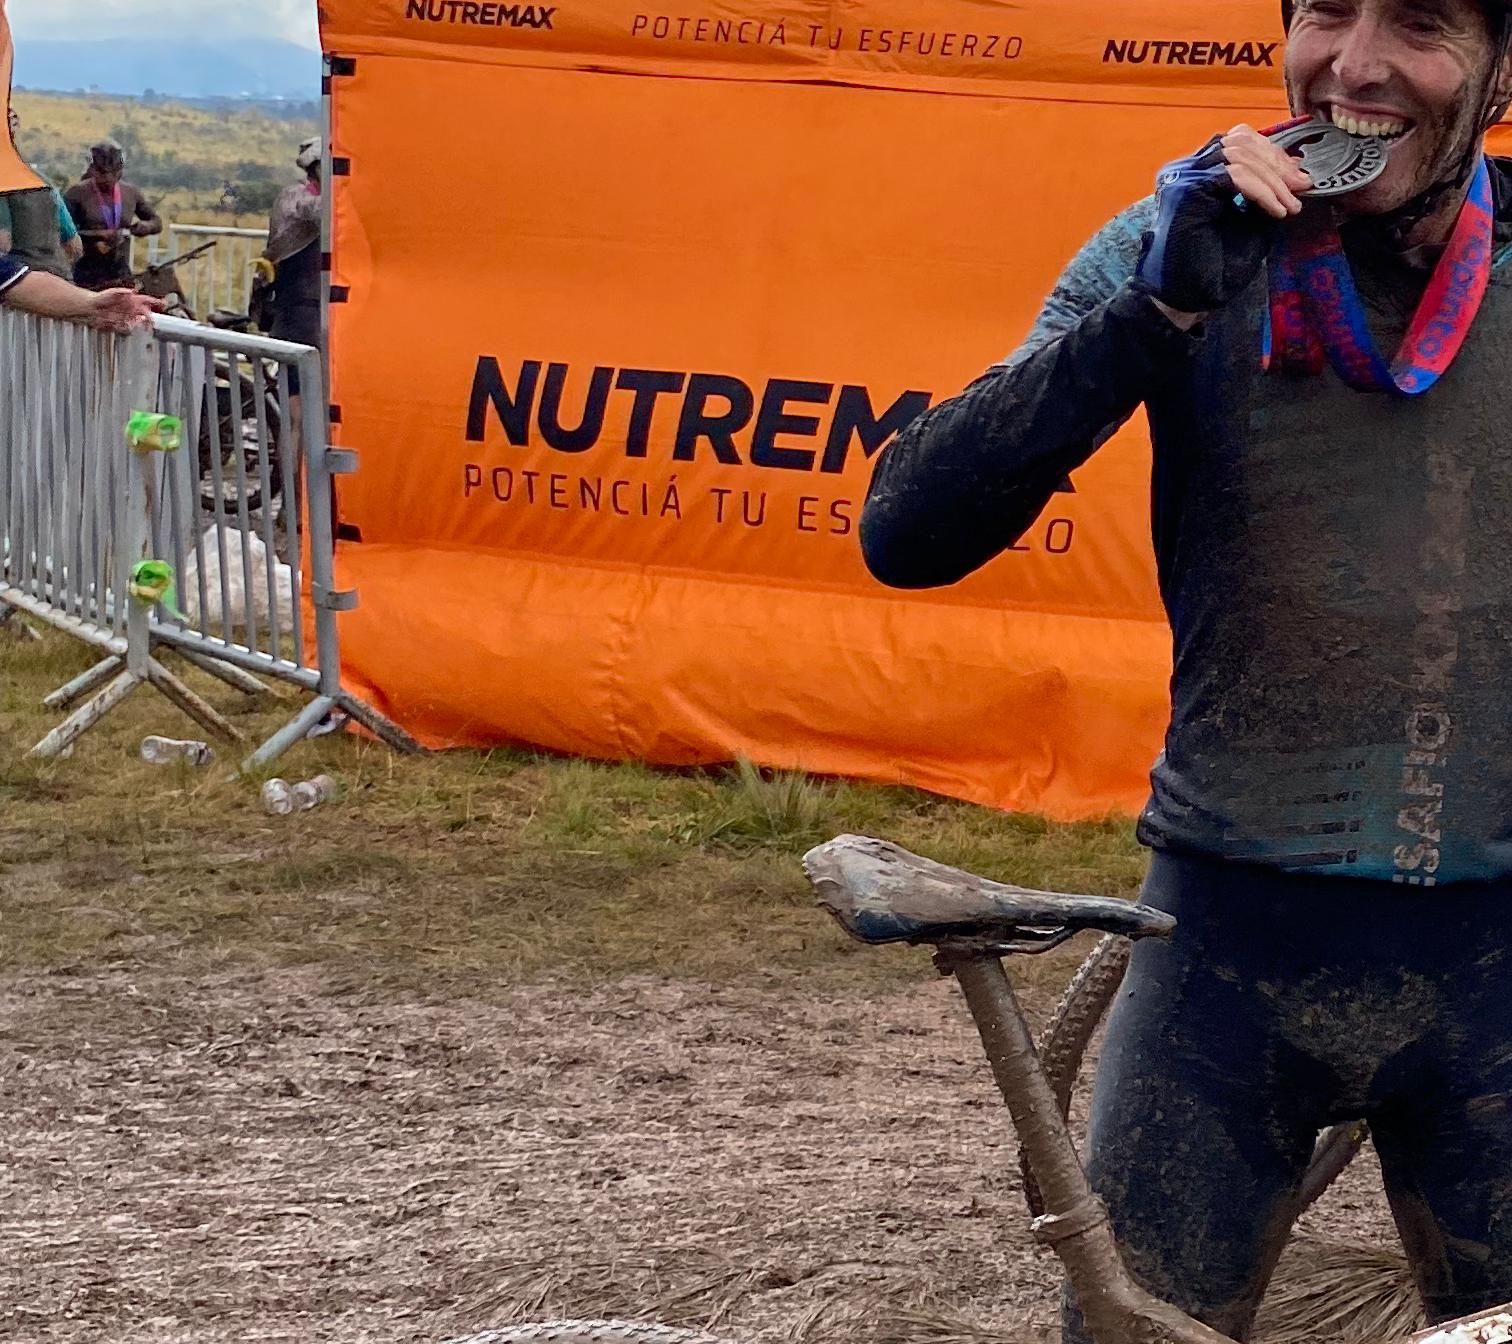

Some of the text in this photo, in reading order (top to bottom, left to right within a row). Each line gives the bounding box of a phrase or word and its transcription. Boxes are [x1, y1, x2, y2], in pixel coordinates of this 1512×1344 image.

[632, 13, 1025, 59] POTENCIÁ TU ESFUERZO
[1102, 38, 1276, 68] NUTREMAX
[465, 356, 1077, 494] NUTREM
[464, 462, 683, 520] POTENCIÁ
[712, 487, 767, 528] TU
